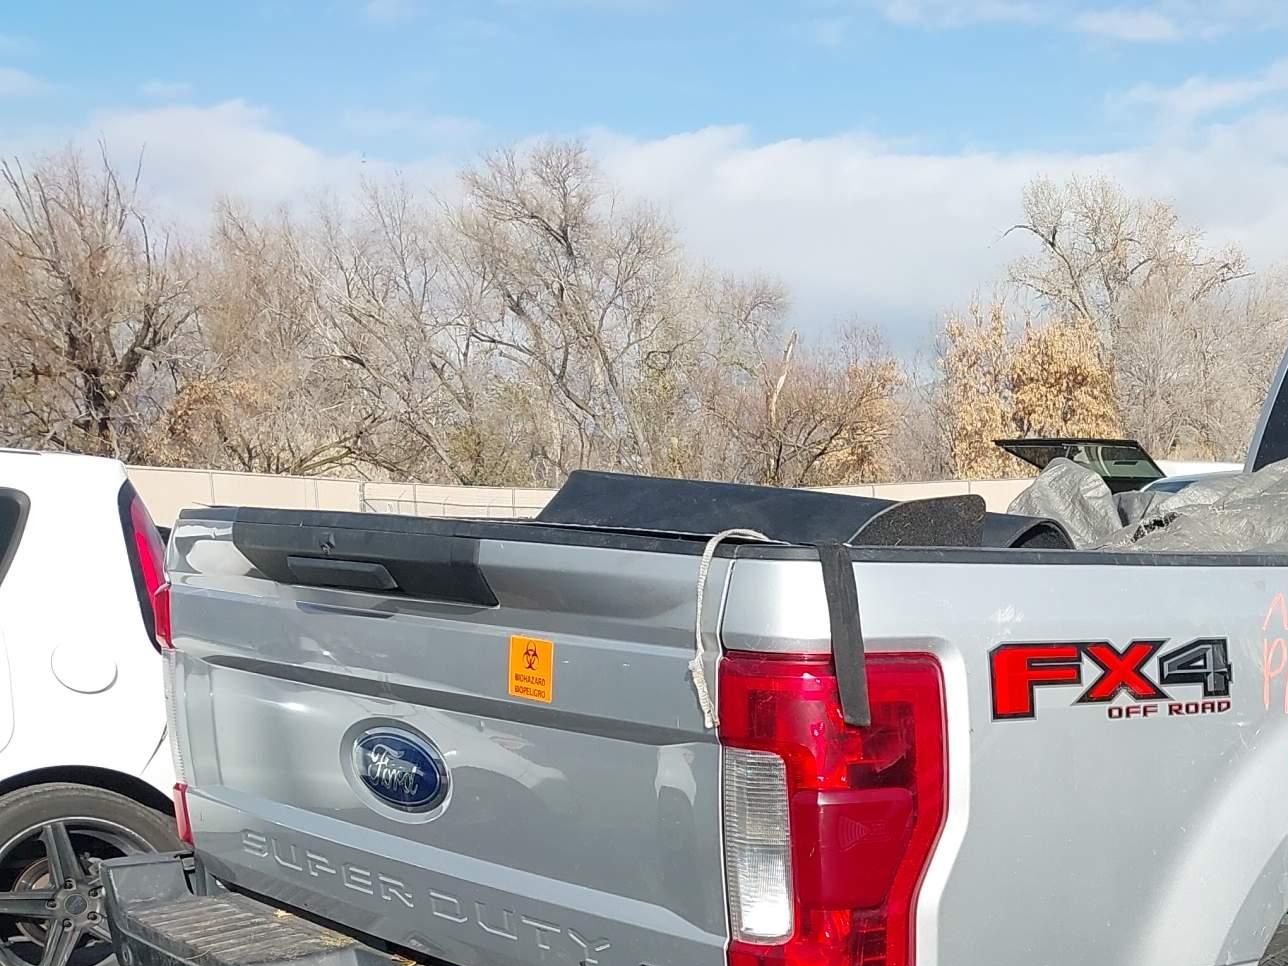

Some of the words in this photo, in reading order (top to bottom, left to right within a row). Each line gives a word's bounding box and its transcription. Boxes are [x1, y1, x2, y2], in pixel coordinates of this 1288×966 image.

[514, 673, 546, 686] BIOHAZARD
[514, 685, 546, 698] BIOPELIGRO
[988, 636, 1233, 722] FX4
[1107, 704, 1158, 720] OFF
[1168, 700, 1231, 716] ROAD
[367, 743, 424, 796] Ford
[240, 829, 416, 908] SUPER
[428, 890, 612, 965] DUTY
